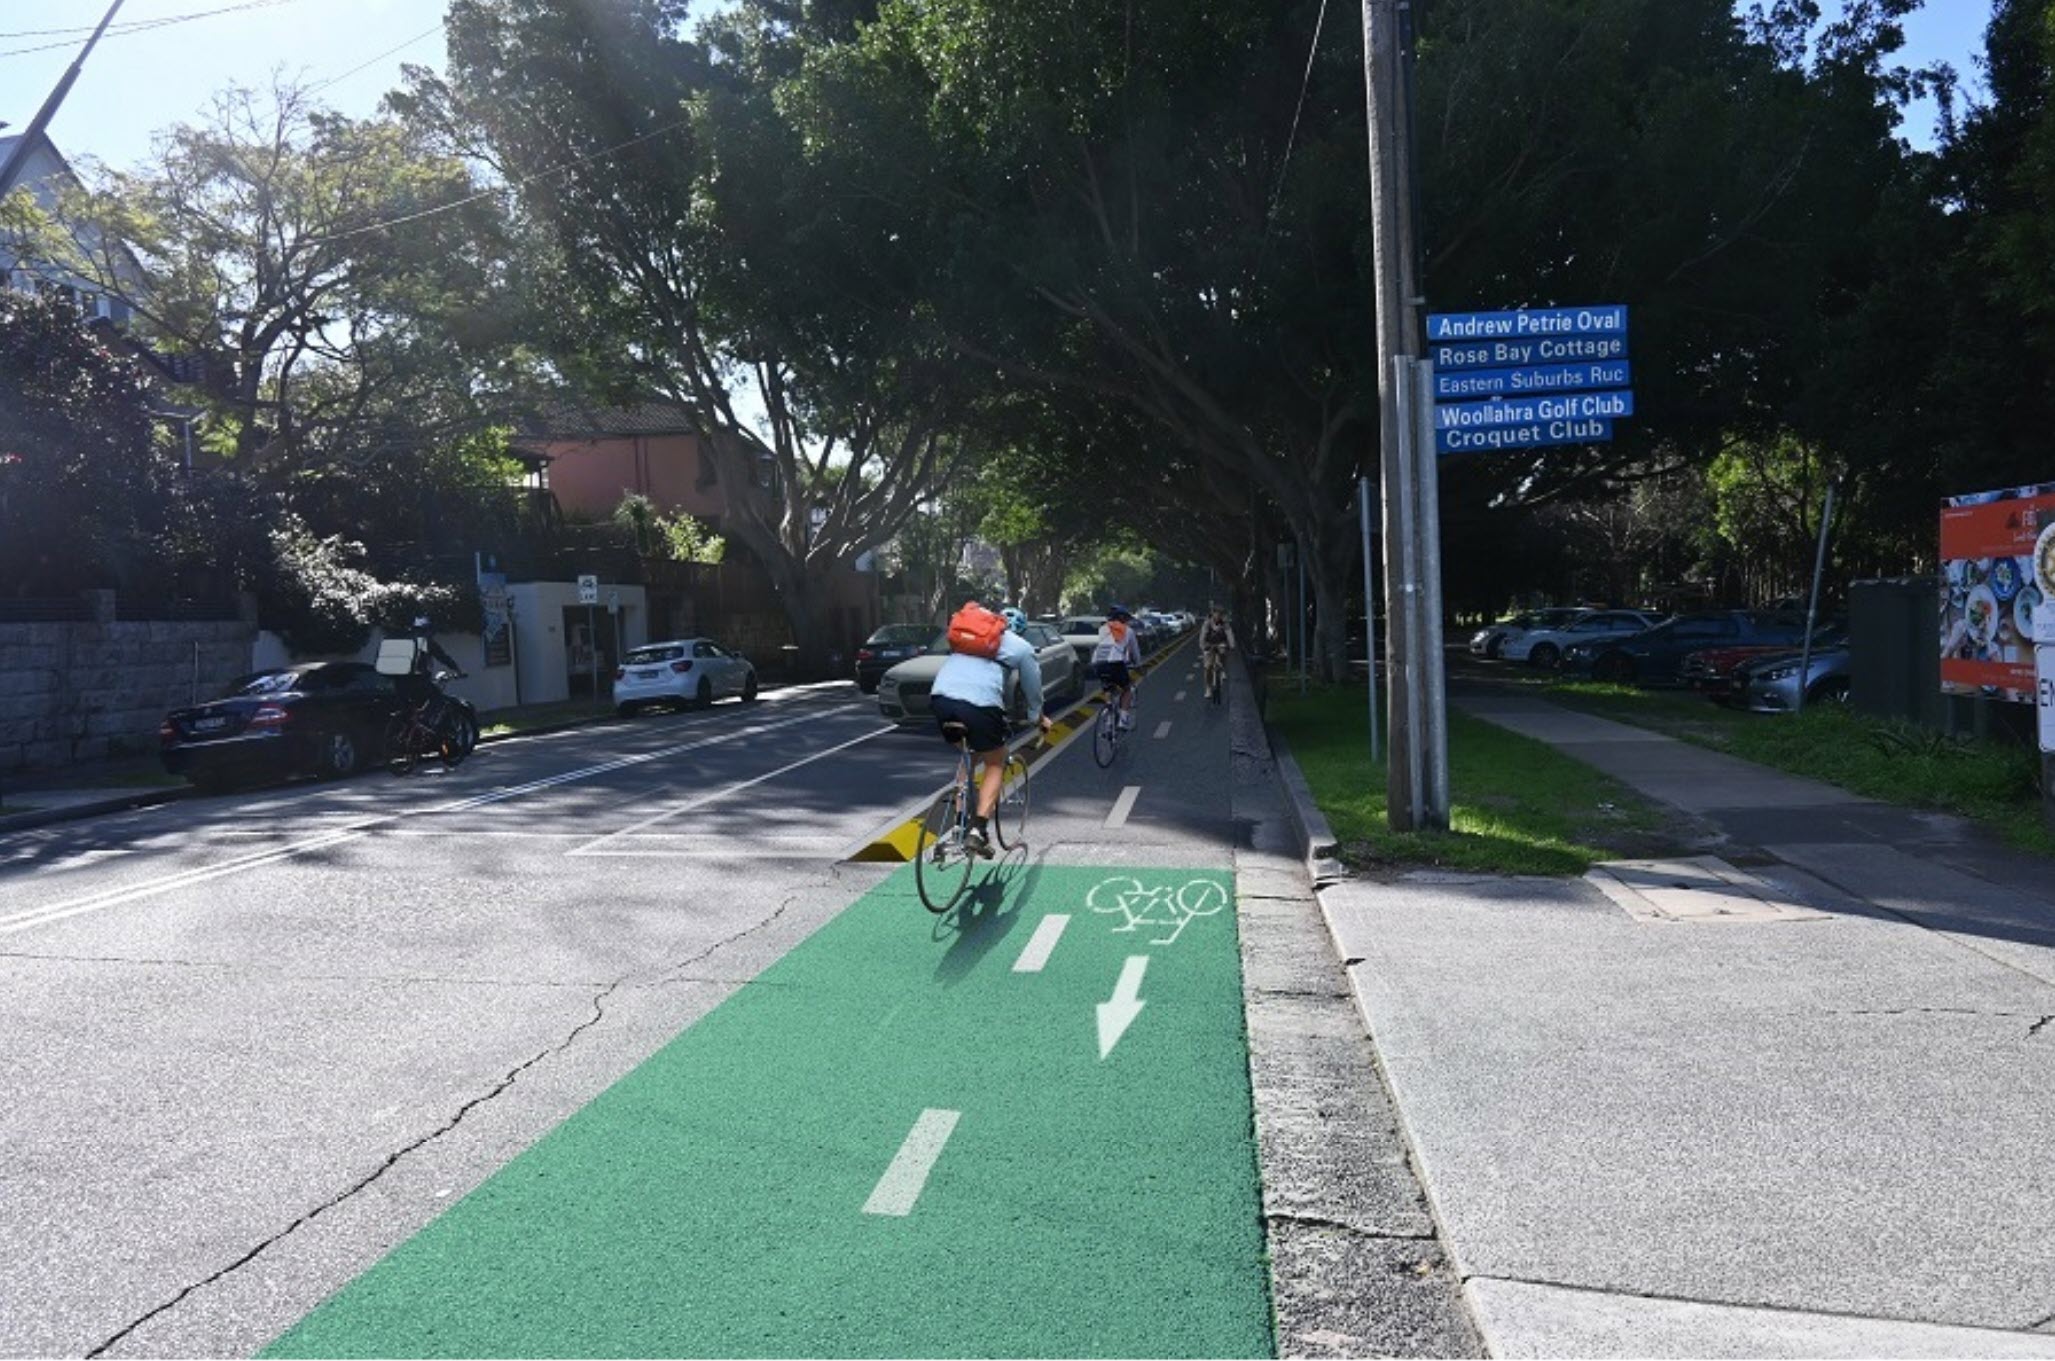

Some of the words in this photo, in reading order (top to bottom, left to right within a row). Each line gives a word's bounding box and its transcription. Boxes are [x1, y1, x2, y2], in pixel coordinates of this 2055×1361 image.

[1439, 316, 1512, 336] Andrew
[1518, 314, 1572, 332] Petrie
[1577, 310, 1620, 330] Oval
[1440, 348, 1489, 365] Rose
[1495, 344, 1532, 362] Bay
[1540, 338, 1621, 358] Cottage
[1440, 376, 1503, 393] Eastern
[1511, 370, 1583, 388] Suburbs
[1442, 406, 1533, 427] Woollahra
[1539, 398, 1578, 418] Golf
[1582, 396, 1625, 416] Club
[1446, 425, 1541, 447] Croquet
[1550, 419, 1604, 438] Club
